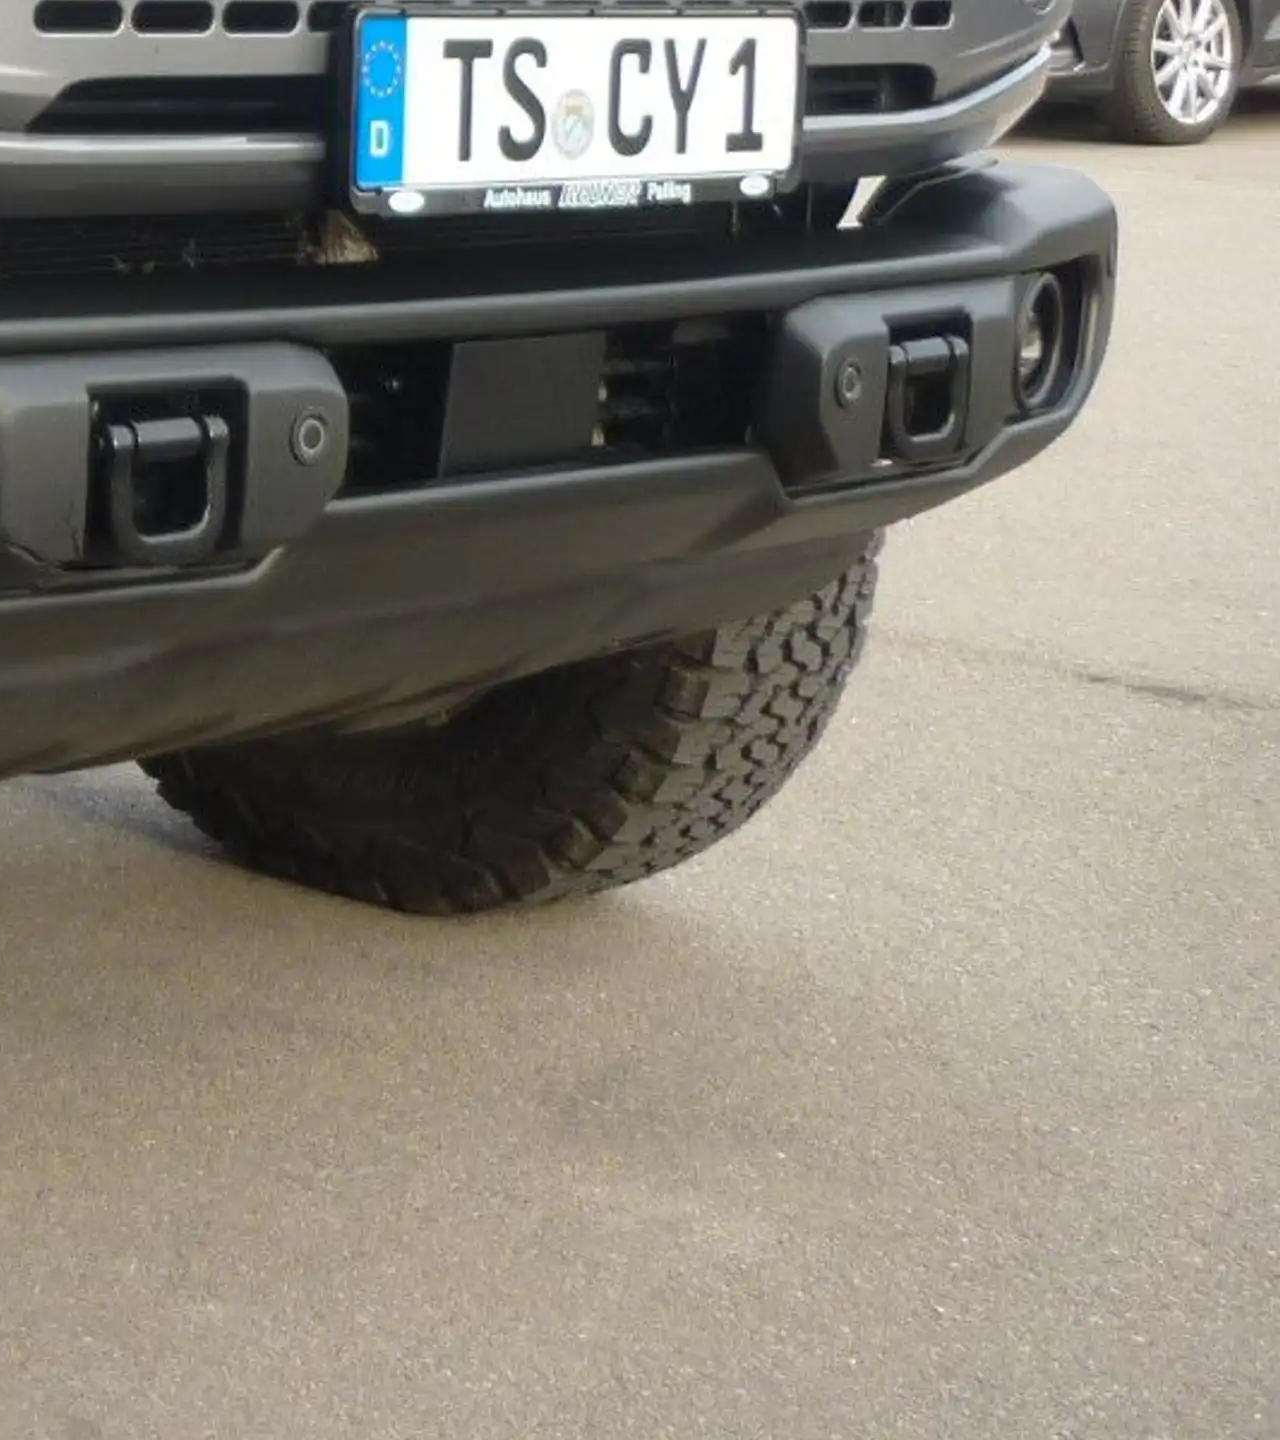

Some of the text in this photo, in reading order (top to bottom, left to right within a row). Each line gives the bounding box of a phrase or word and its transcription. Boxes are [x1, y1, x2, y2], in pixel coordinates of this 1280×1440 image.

[442, 37, 547, 162] TS
[369, 119, 391, 158] D
[483, 187, 552, 208] Autohaus
